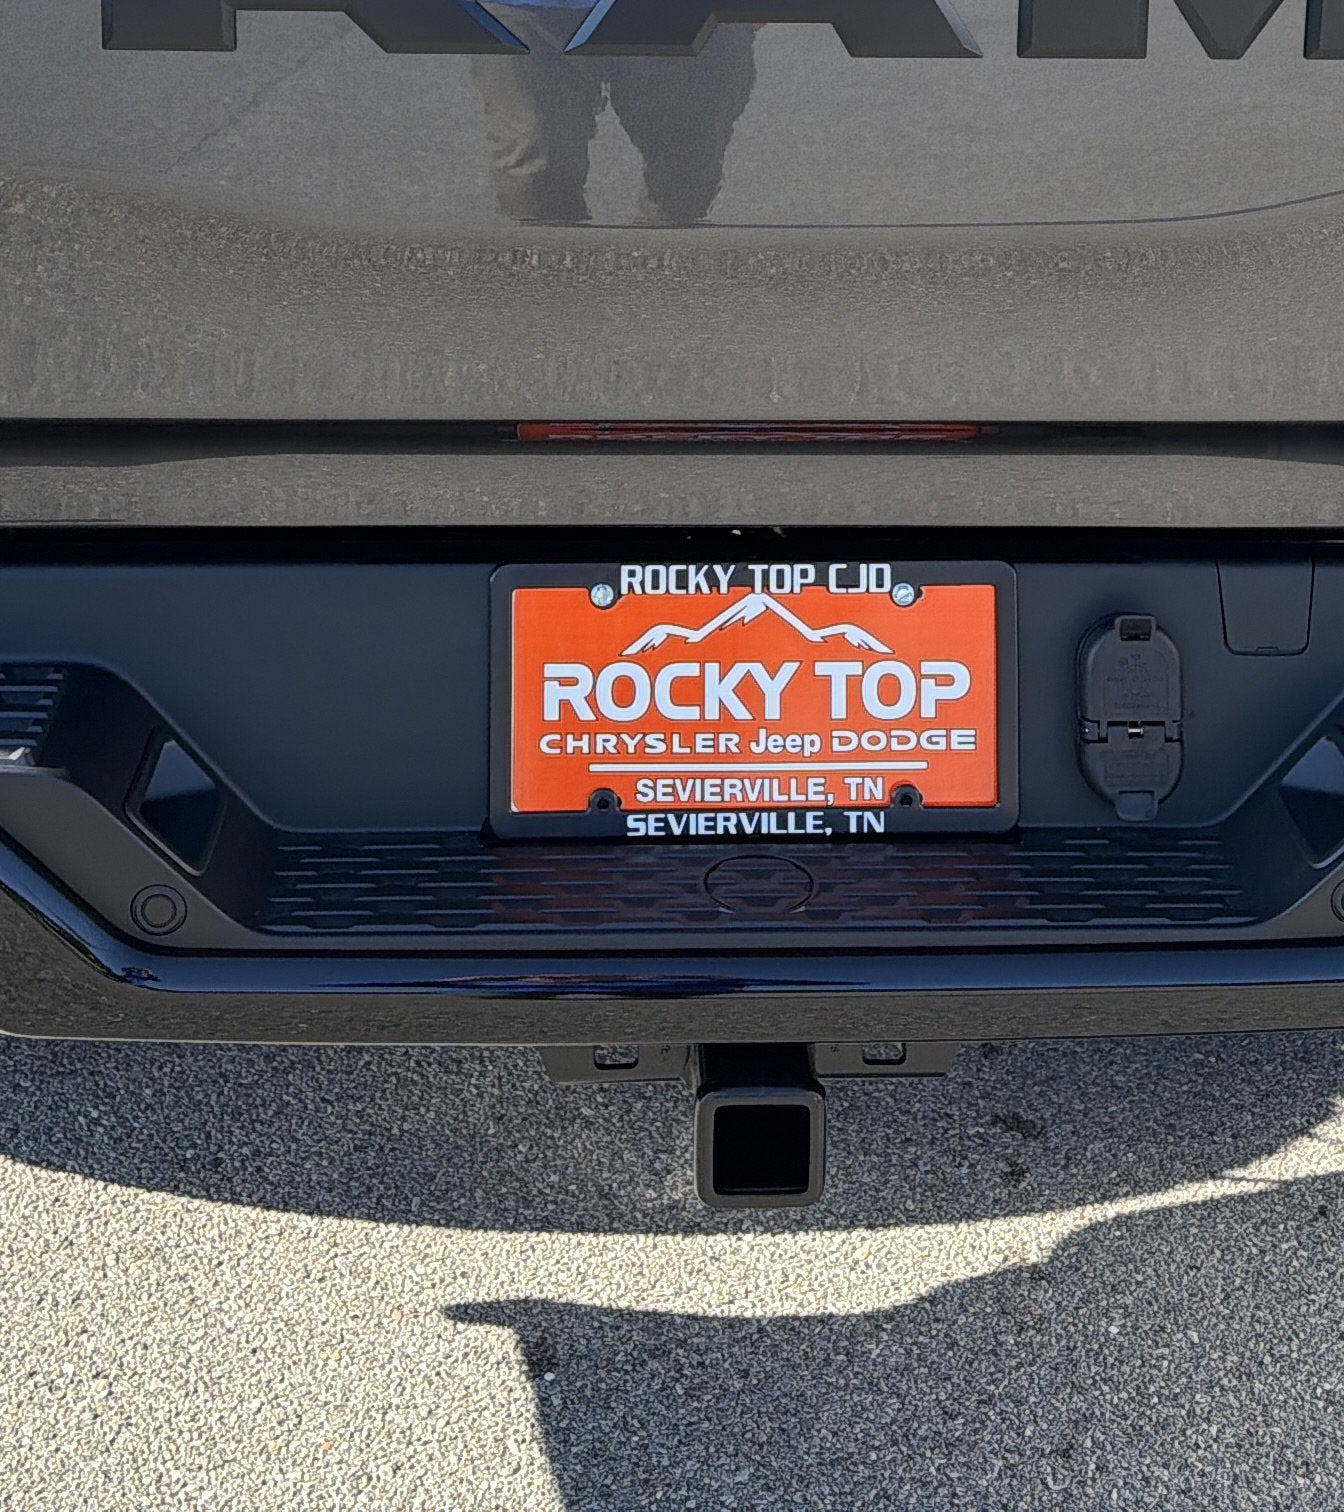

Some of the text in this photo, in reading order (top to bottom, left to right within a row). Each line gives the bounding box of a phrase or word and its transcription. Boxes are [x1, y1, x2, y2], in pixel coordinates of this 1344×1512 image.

[619, 562, 892, 595] ROCKY TOP CJD
[542, 660, 972, 723] ROCKY TOP
[539, 727, 977, 757] CHRYSLER Jeep DODGE
[634, 776, 884, 807] SEVIERVILLE, TN
[625, 810, 885, 838] SEVIERVILLE, TN
